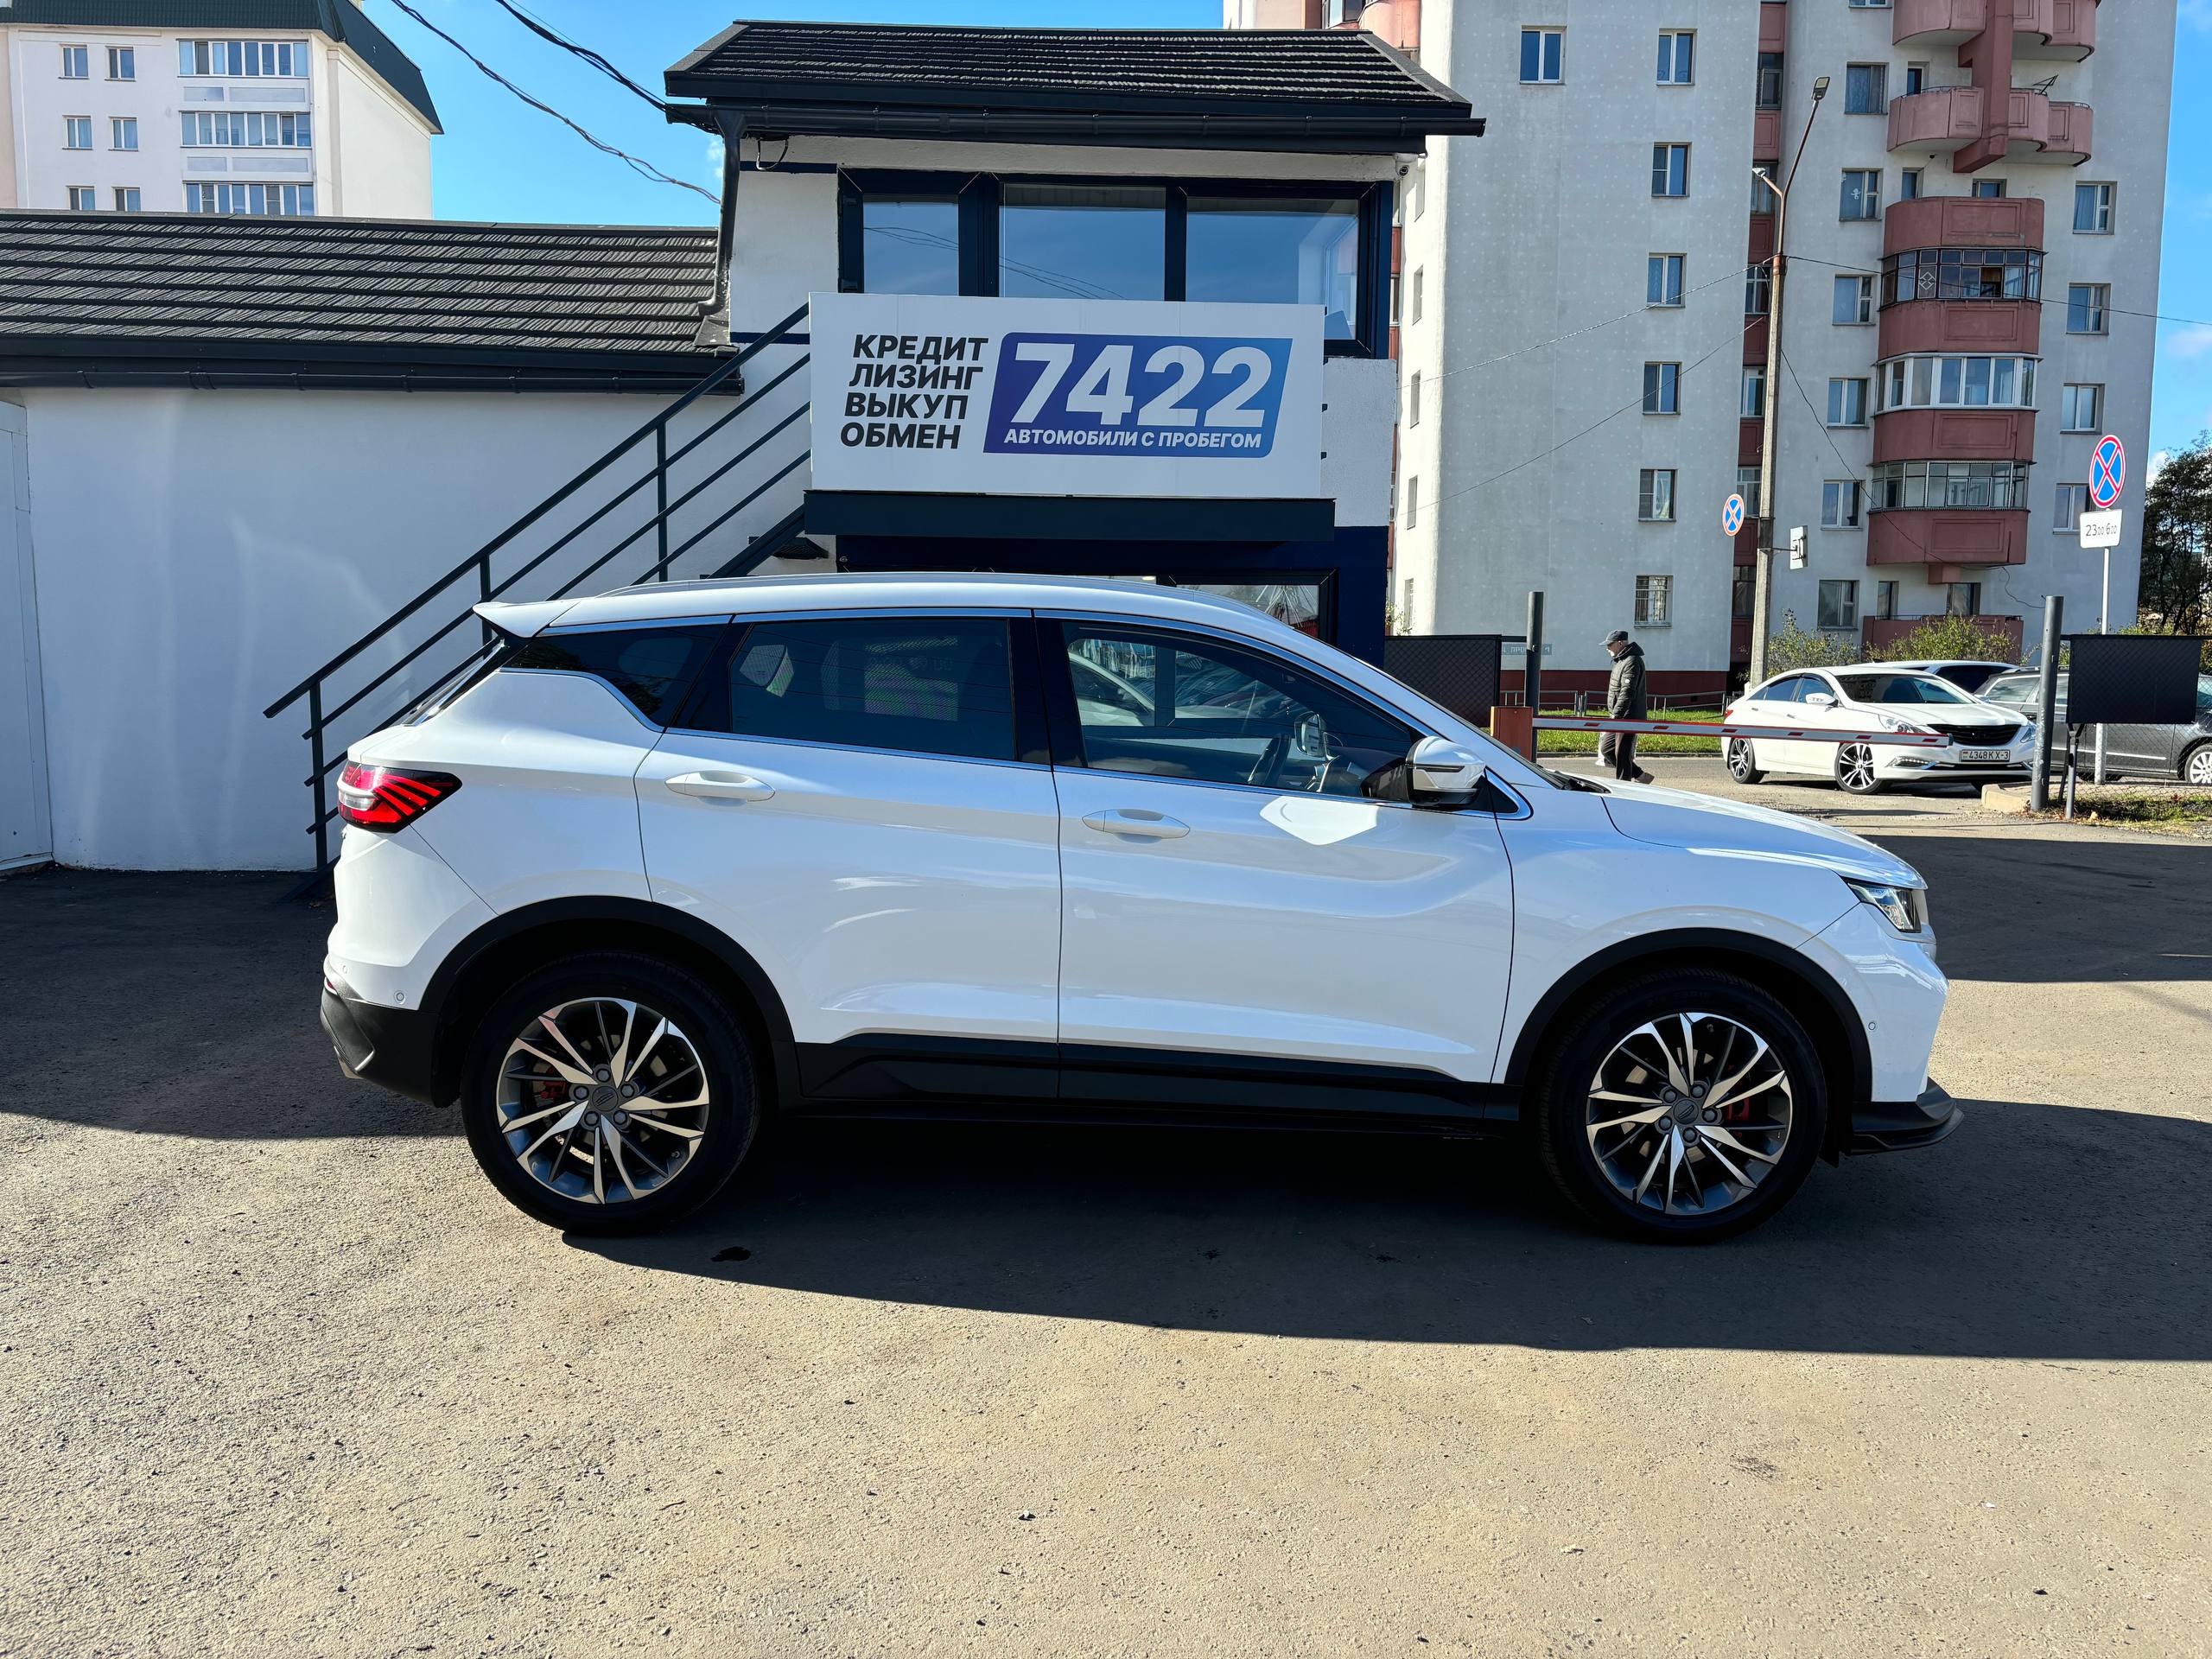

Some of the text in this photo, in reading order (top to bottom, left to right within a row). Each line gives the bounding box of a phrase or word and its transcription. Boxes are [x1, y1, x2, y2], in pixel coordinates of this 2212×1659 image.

[853, 334, 989, 365] КРЕДИТ
[849, 363, 984, 391] ЛИЗИНГ
[1010, 342, 1273, 428] 7422
[844, 391, 969, 420] ВЫКУП
[840, 422, 962, 449] ОБМЕН
[1003, 429, 1262, 448] АВТОМОБИЛИ С ПРОБЕГОМ
